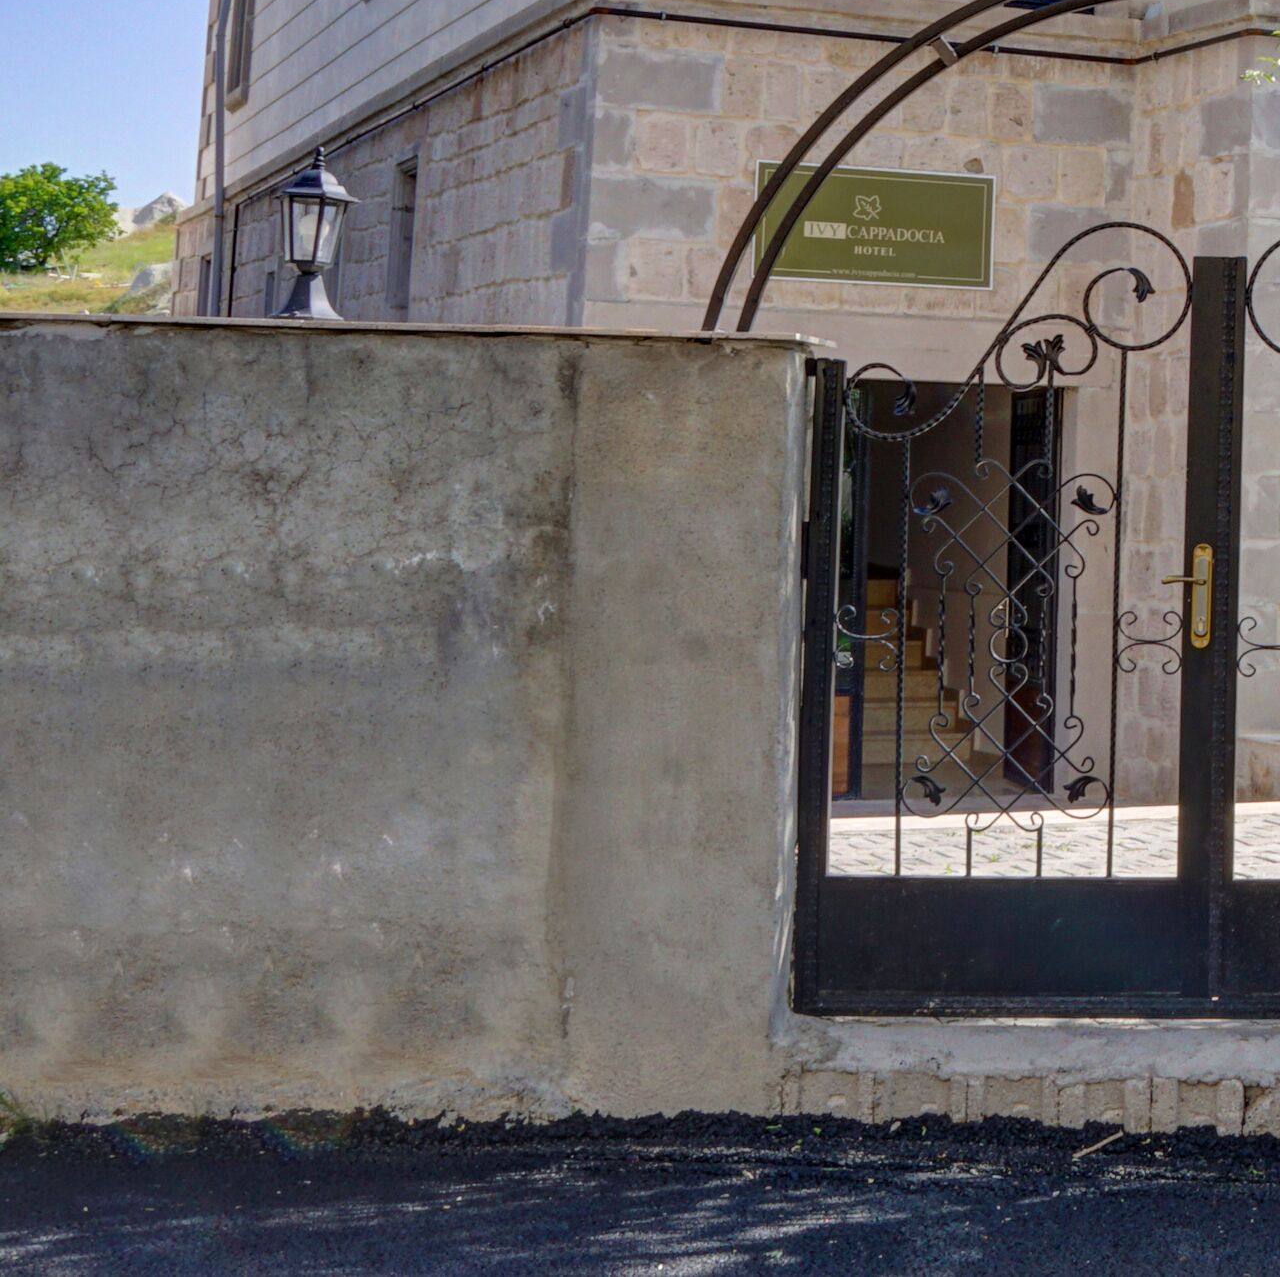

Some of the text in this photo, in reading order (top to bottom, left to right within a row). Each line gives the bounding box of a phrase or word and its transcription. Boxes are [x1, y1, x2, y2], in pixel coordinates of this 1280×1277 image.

[806, 223, 945, 244] IVY CAPPADOCIA
[854, 245, 896, 257] HOTEL
